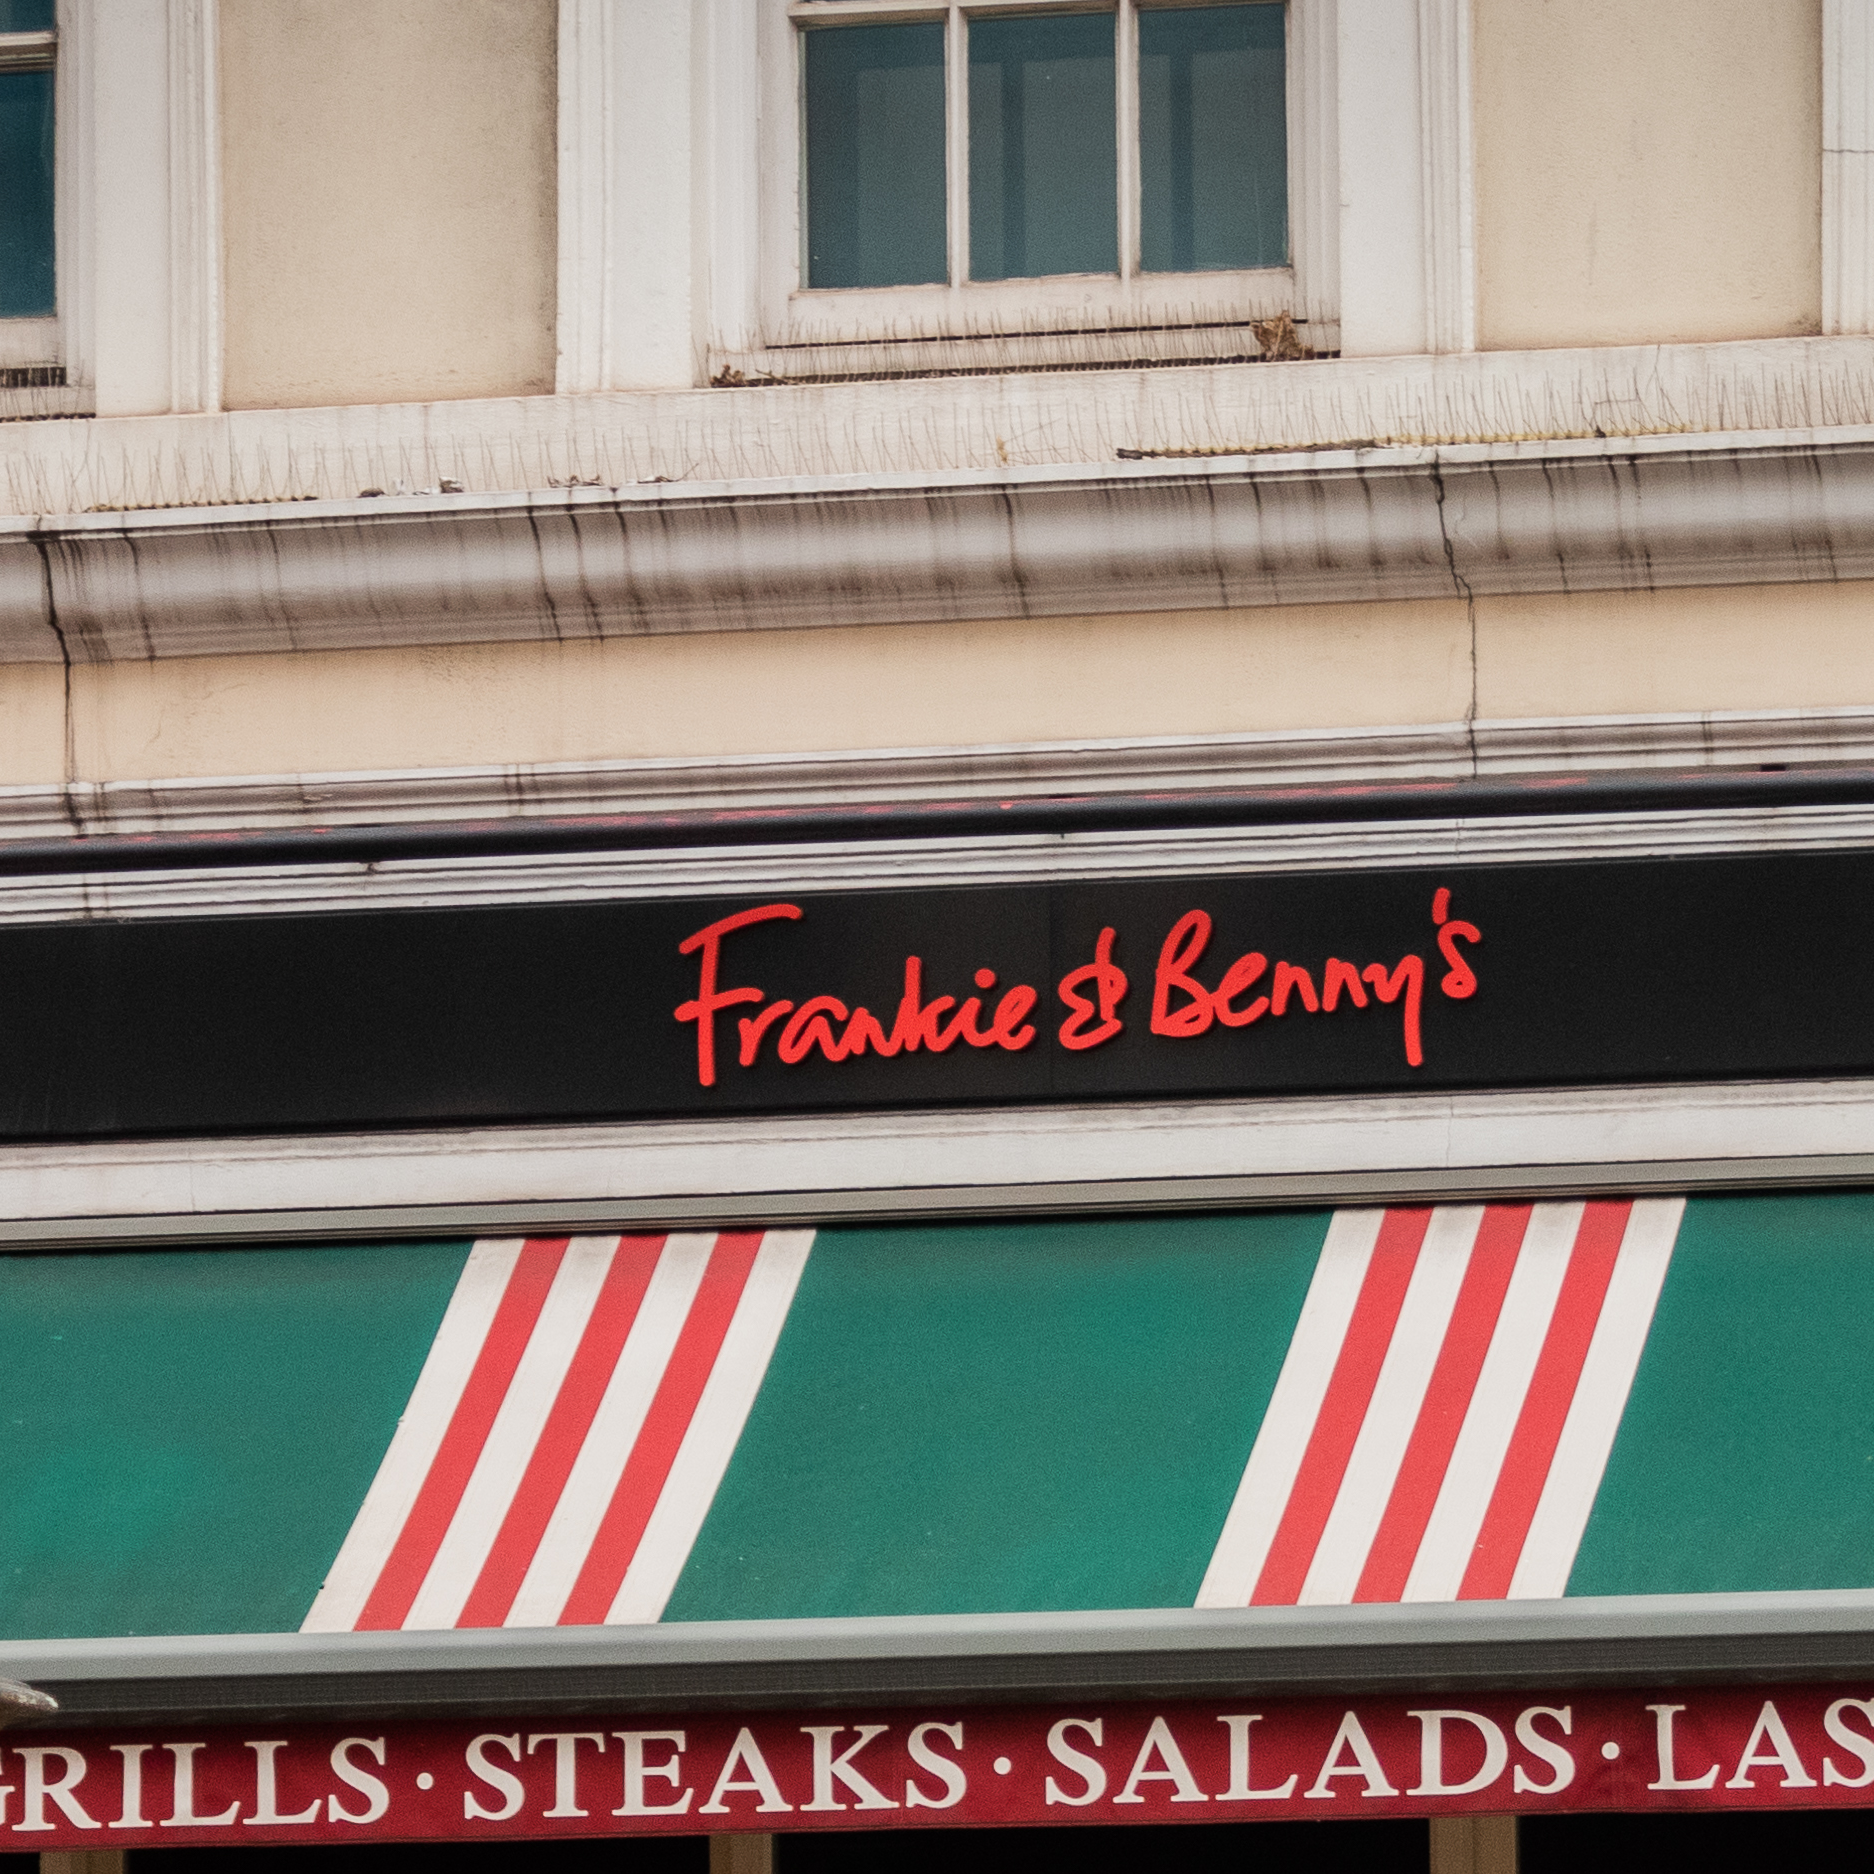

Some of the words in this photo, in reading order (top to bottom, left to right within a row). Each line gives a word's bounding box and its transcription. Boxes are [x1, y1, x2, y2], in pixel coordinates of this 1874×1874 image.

[674, 904, 1036, 1086] Frankie
[1057, 927, 1128, 1051] &
[1149, 887, 1481, 1067] Benny's
[463, 1721, 967, 1822] STEAKS
[1045, 1705, 1575, 1807] SALADS
